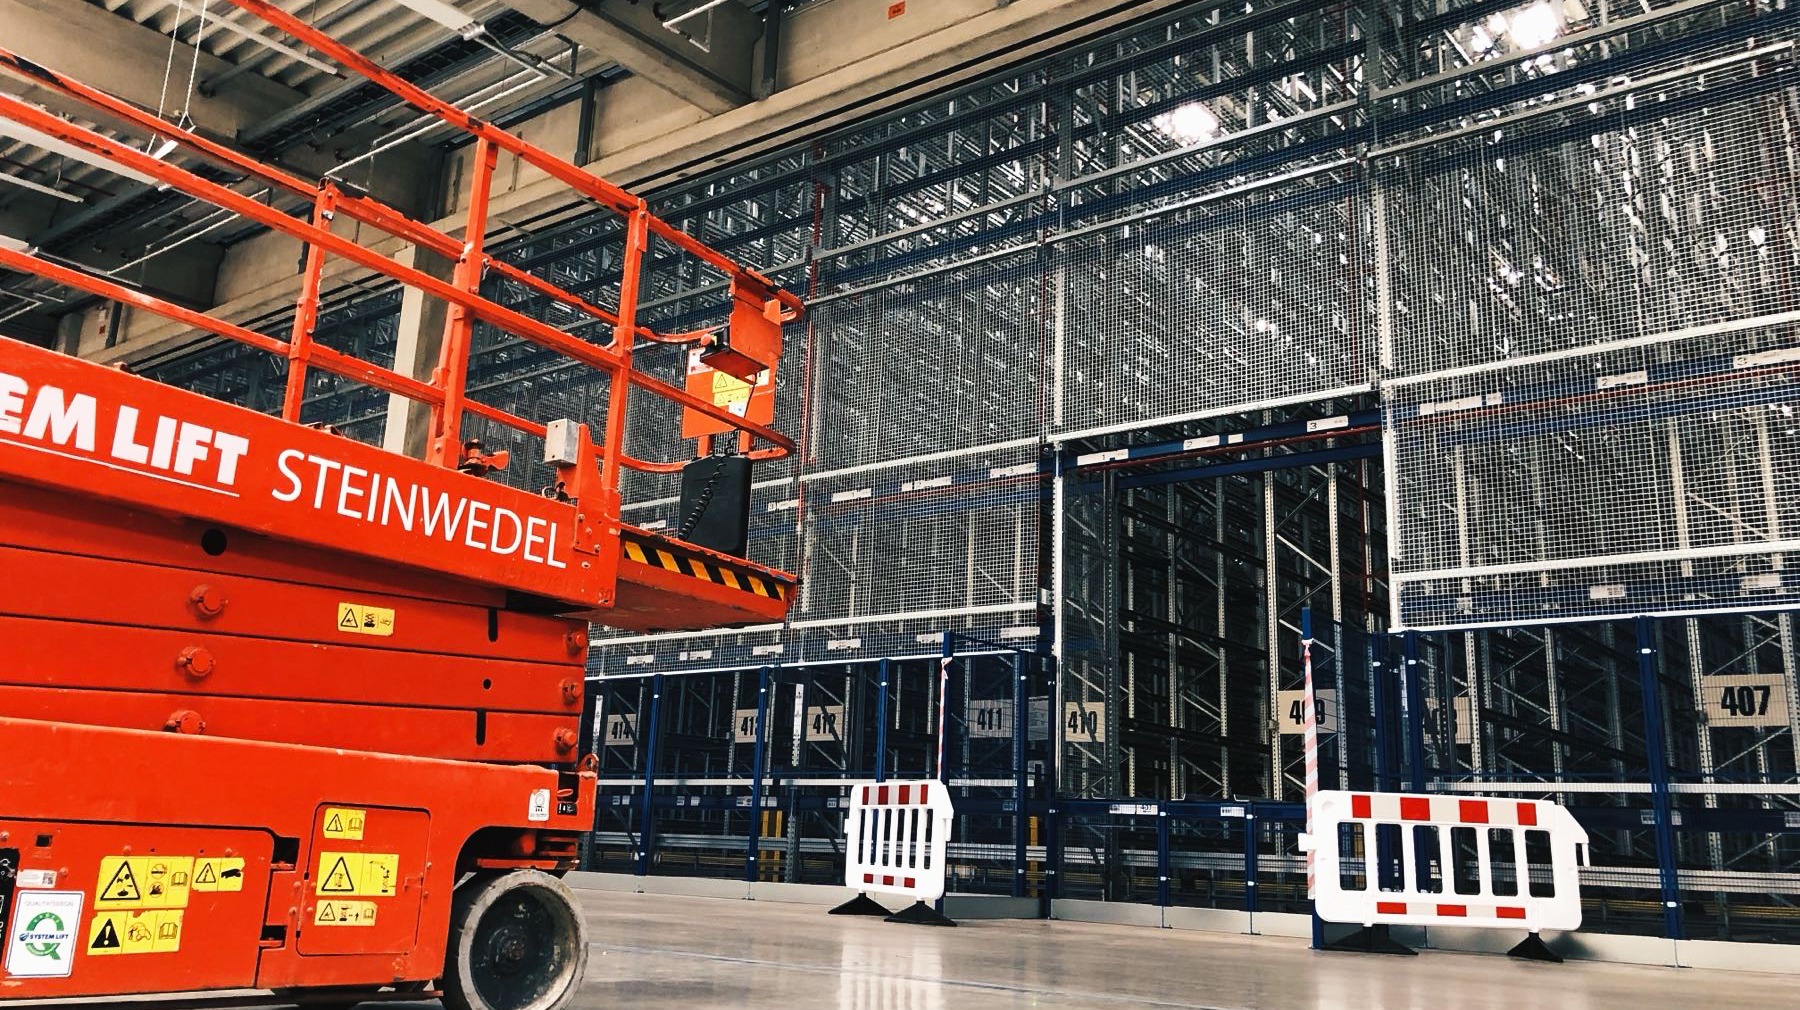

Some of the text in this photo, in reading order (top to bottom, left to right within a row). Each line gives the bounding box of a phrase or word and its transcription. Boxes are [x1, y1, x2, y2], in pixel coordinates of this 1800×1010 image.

[1309, 421, 1318, 431] 3
[1185, 440, 1193, 449] 2
[111, 404, 249, 486] LIFT
[271, 448, 567, 569] STEINWEDEL
[1289, 699, 1326, 726] 49
[1721, 685, 1771, 717] 407
[741, 716, 759, 736] 41
[977, 708, 1003, 731] 411
[1067, 710, 1098, 735] 410
